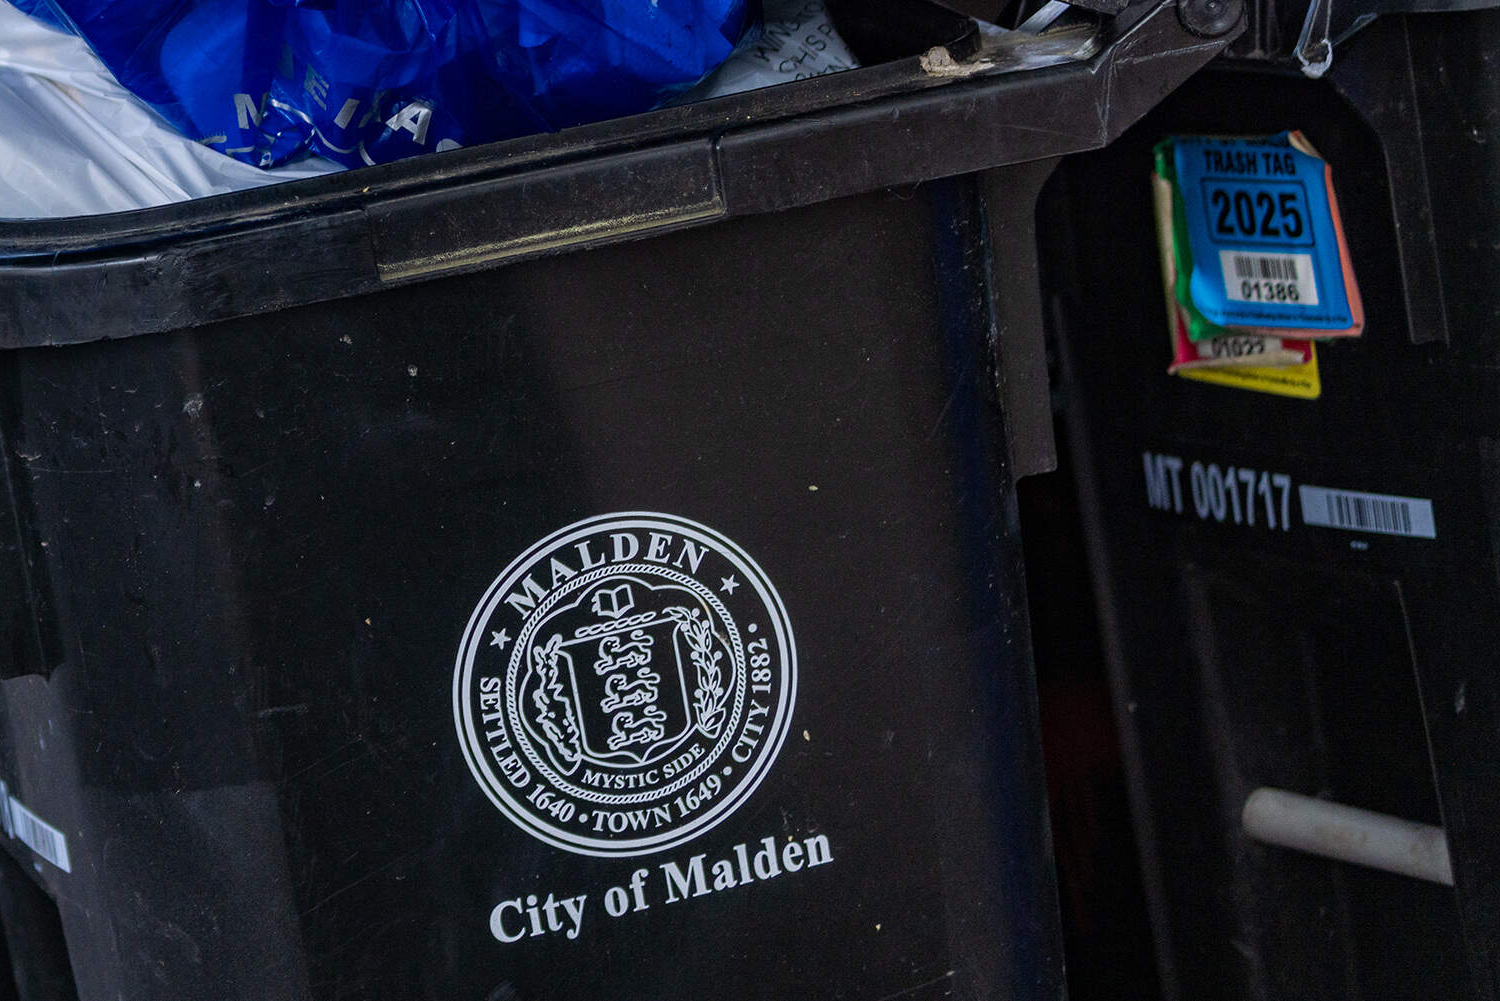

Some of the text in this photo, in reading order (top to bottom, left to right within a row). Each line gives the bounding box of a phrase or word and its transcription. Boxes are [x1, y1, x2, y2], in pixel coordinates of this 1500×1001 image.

[1203, 151, 1296, 176] TRASH TAG
[1212, 189, 1304, 238] 2025
[1241, 281, 1299, 302] 01386
[1190, 460, 1292, 532] 001717
[504, 532, 709, 620] MALDEN
[480, 637, 773, 834] SETTLED 1640 TOWN 1649 CITY 1882
[580, 743, 706, 790] MYSTIC SIDE
[489, 832, 834, 944] City of Malden
